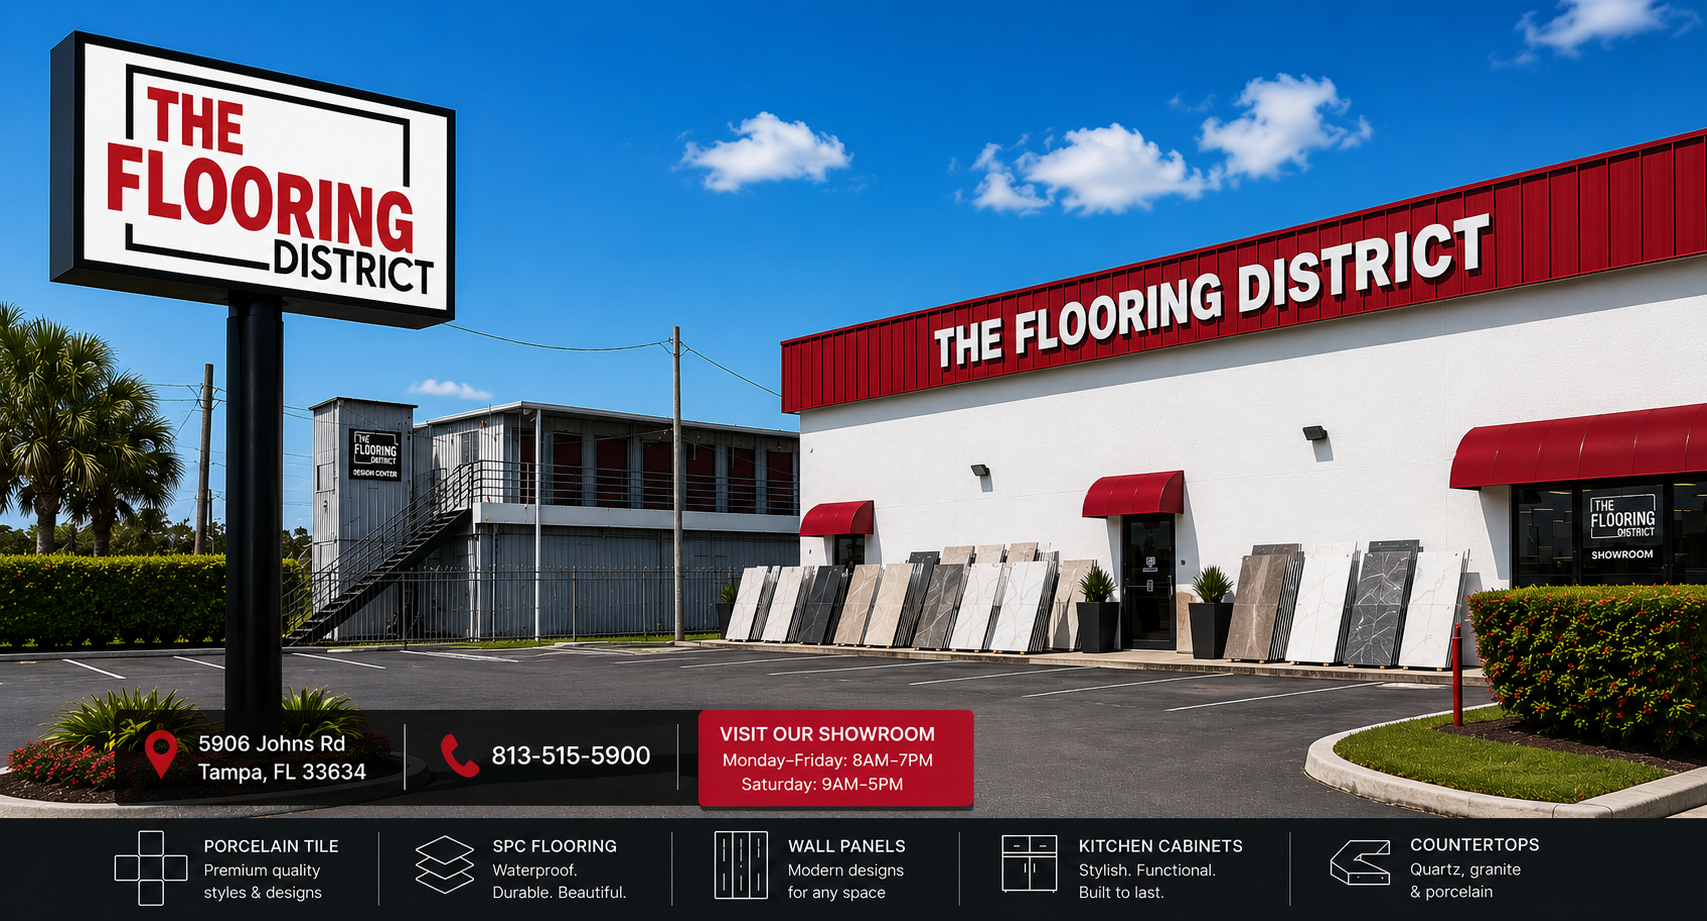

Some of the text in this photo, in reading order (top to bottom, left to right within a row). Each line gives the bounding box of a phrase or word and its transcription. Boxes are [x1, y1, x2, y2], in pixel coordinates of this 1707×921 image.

[147, 86, 244, 156] THE
[107, 142, 414, 254] FLOORING
[273, 239, 435, 295] DISTRICT
[933, 212, 1491, 369] THE FLOORING DISTRICT
[354, 443, 397, 457] FLOORING
[1595, 500, 1615, 512] THE
[1591, 511, 1656, 528] FLOORING
[1617, 527, 1655, 538] DISTRICT
[1591, 549, 1654, 560] SHOWROOM
